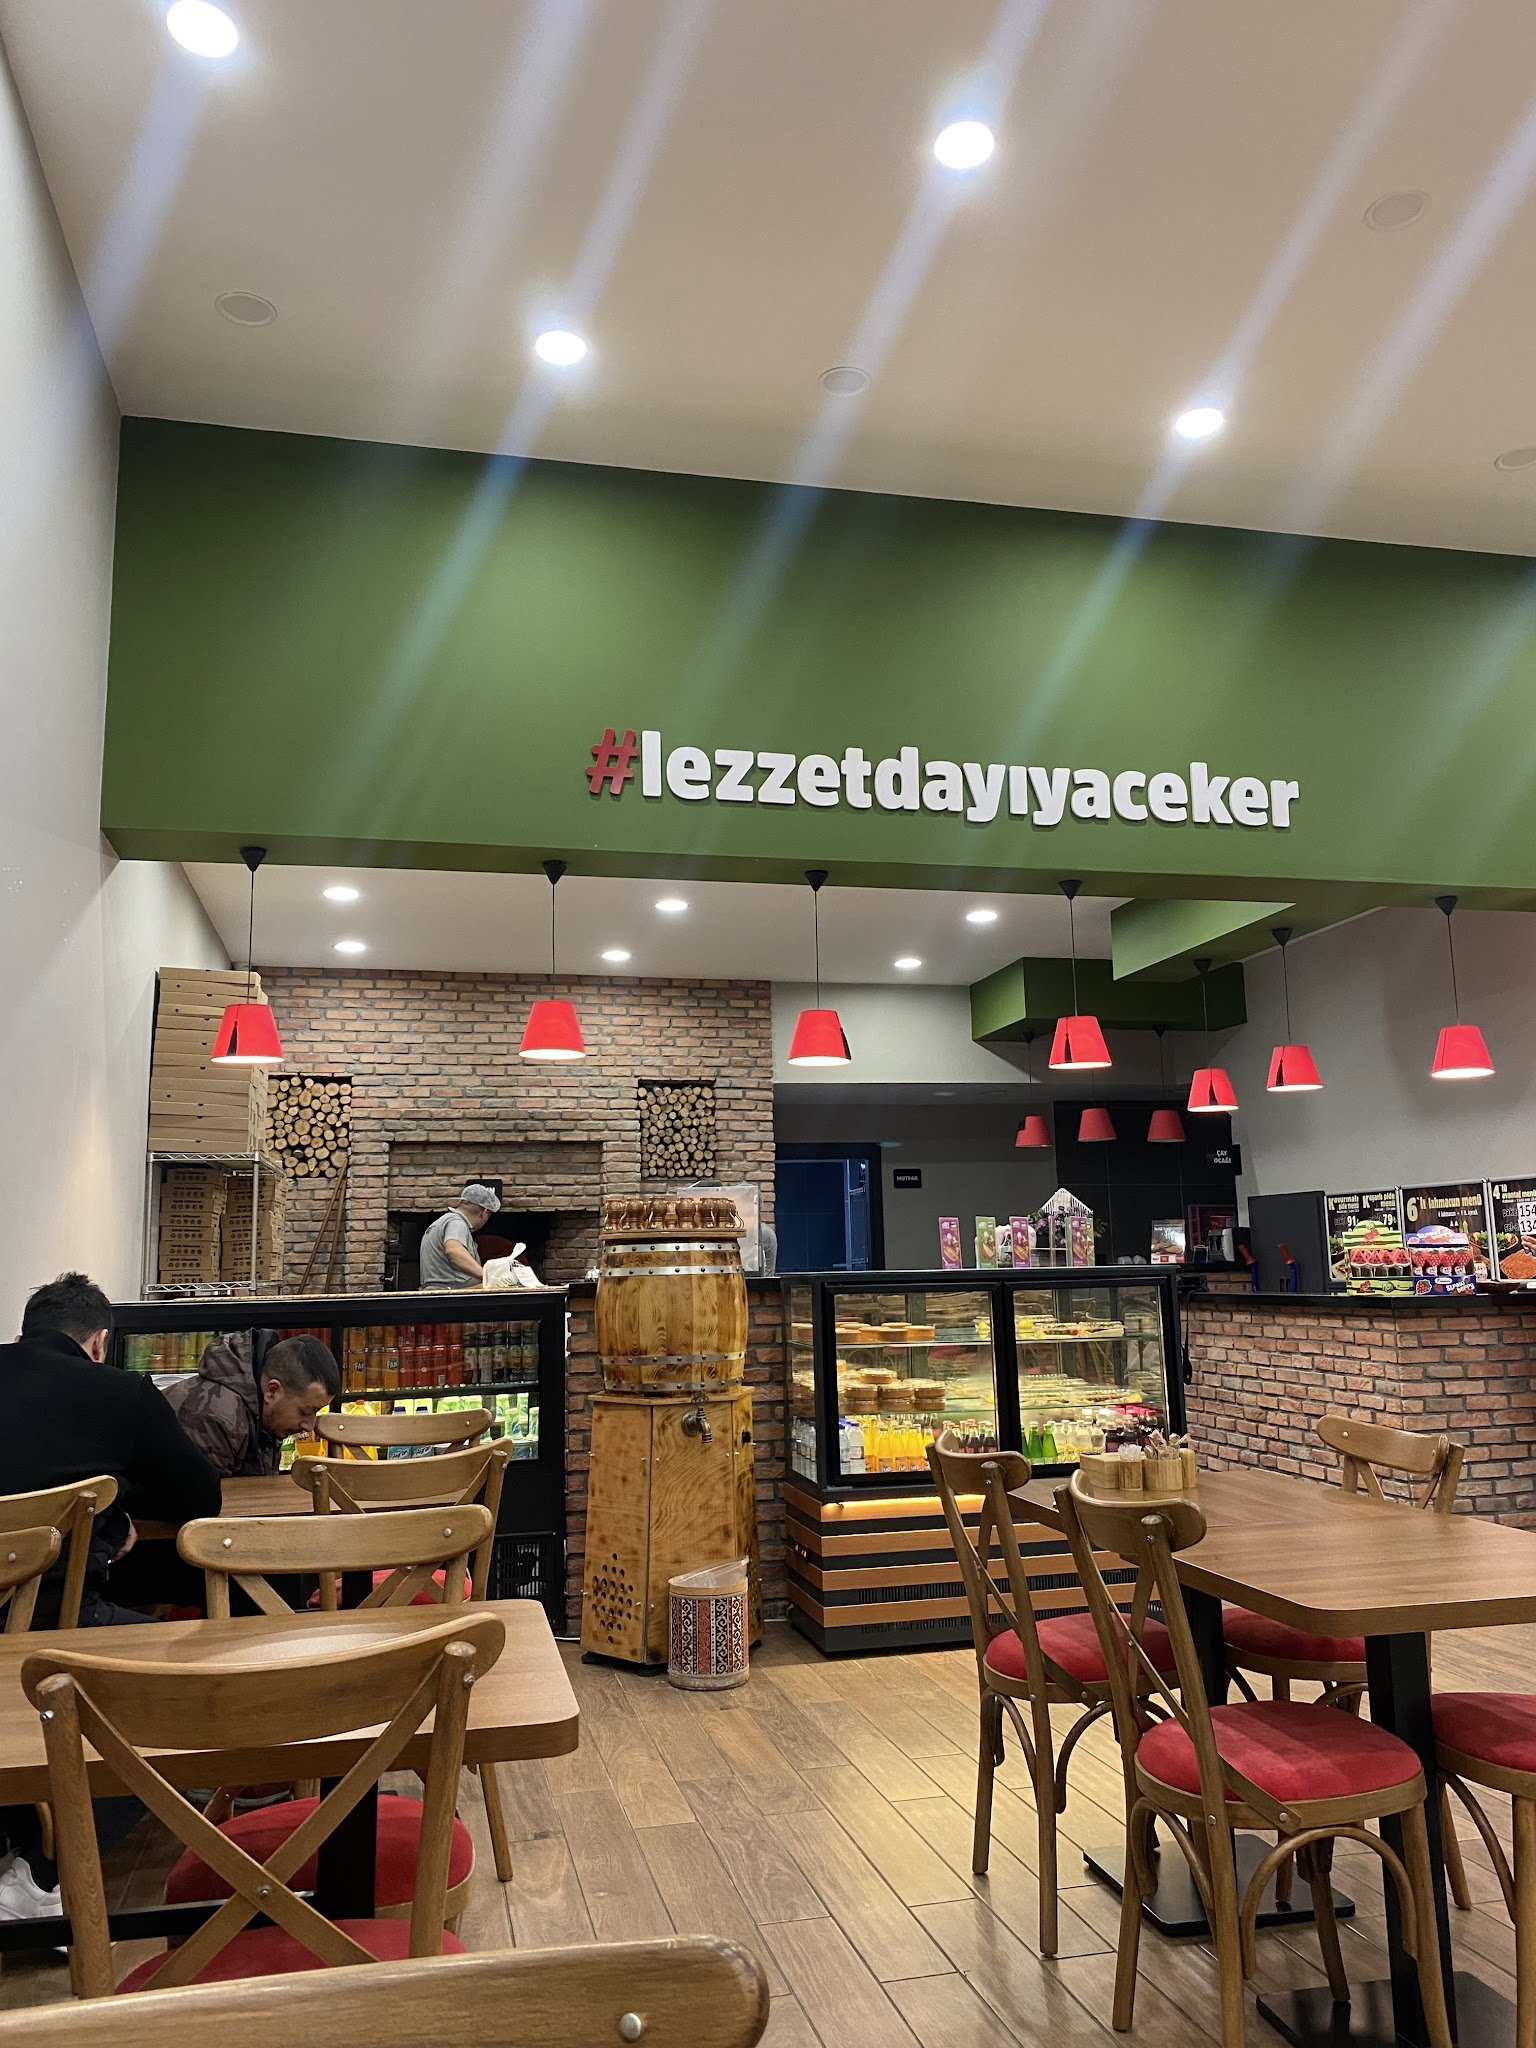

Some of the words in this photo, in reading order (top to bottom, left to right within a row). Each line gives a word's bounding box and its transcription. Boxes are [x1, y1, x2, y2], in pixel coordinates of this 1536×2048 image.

[585, 728, 1299, 828] #lezzetdayıyaceker
[1427, 1197, 1461, 1210] lahmacun
[1461, 1193, 1483, 1207] menü
